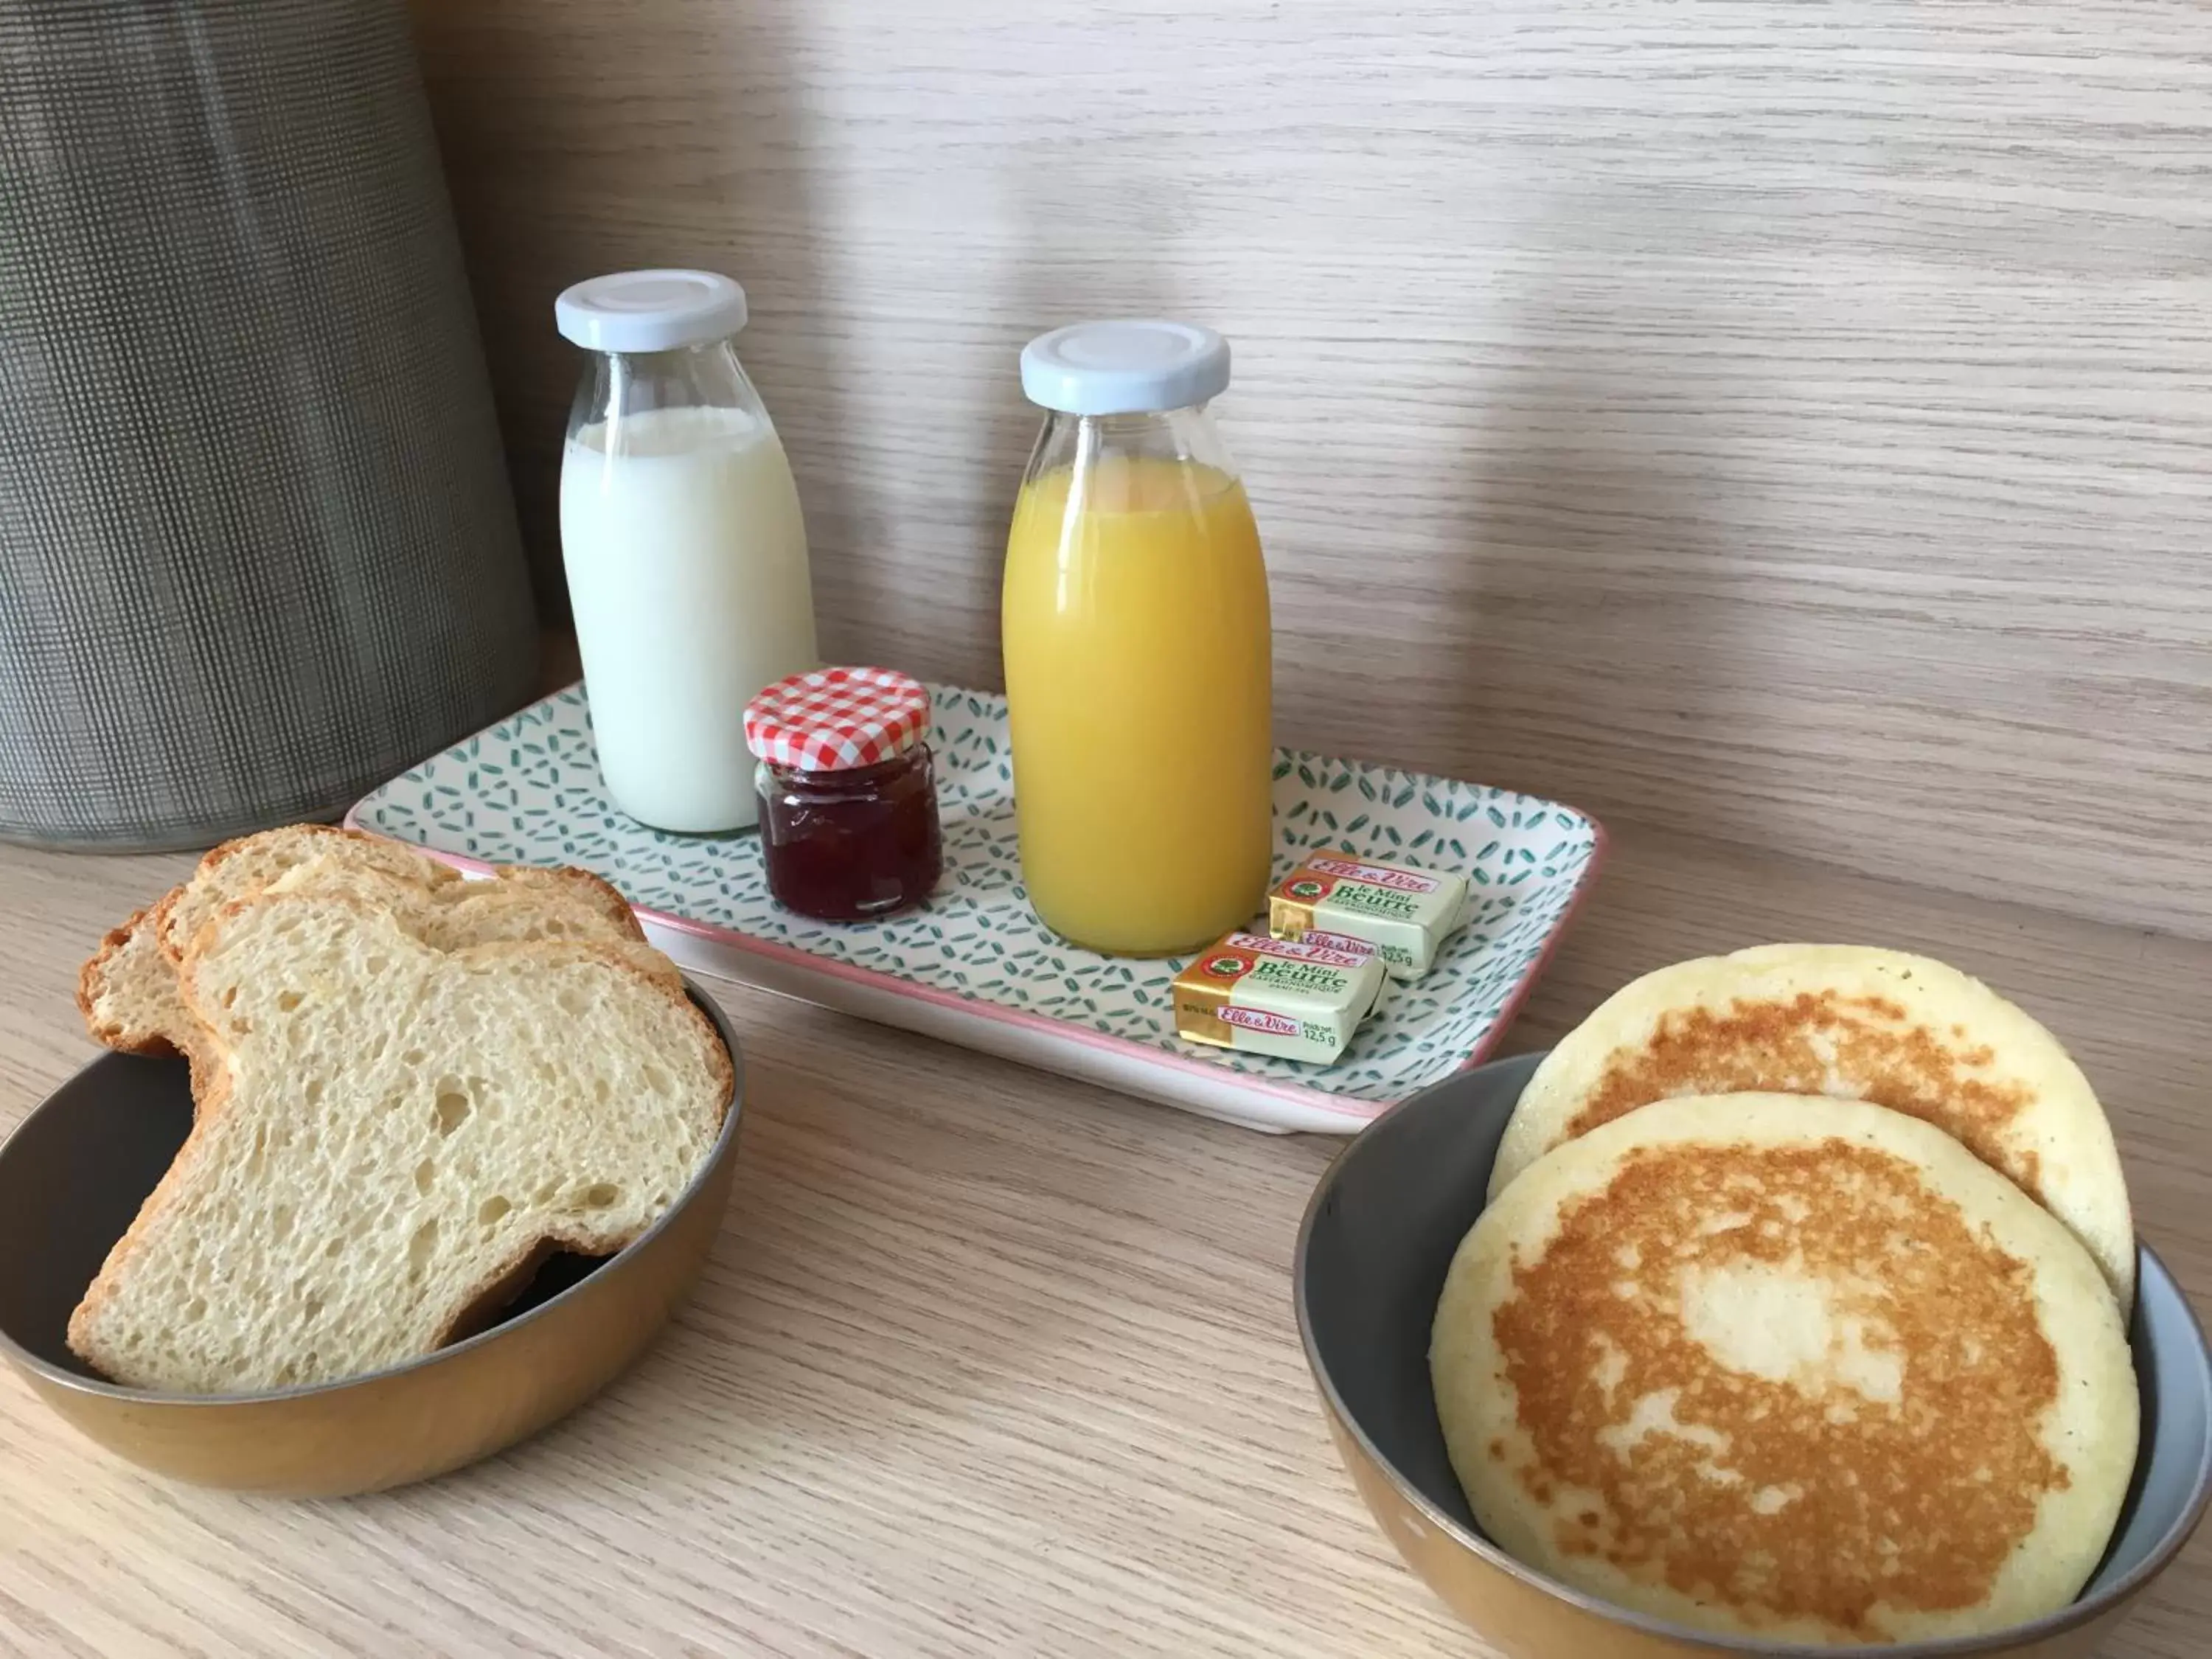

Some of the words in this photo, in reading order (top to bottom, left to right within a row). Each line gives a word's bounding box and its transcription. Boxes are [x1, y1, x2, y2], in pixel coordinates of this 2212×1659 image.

[1313, 860, 1363, 876] Elle
[1363, 872, 1378, 881] &
[1381, 871, 1431, 889] Vire
[1335, 886, 1420, 912] Beurre
[1374, 887, 1413, 902] Mini
[1233, 937, 1285, 953] Elle
[1285, 947, 1302, 956] &
[1306, 945, 1358, 965] Vire
[1306, 932, 1334, 948] Elle
[1256, 961, 1349, 987] Beurre
[1300, 964, 1340, 977] Mini
[1221, 1008, 1252, 1024] Elle
[1253, 1018, 1262, 1027] &
[1265, 1015, 1297, 1033] Vire
[1304, 1029, 1325, 1042] 12,5
